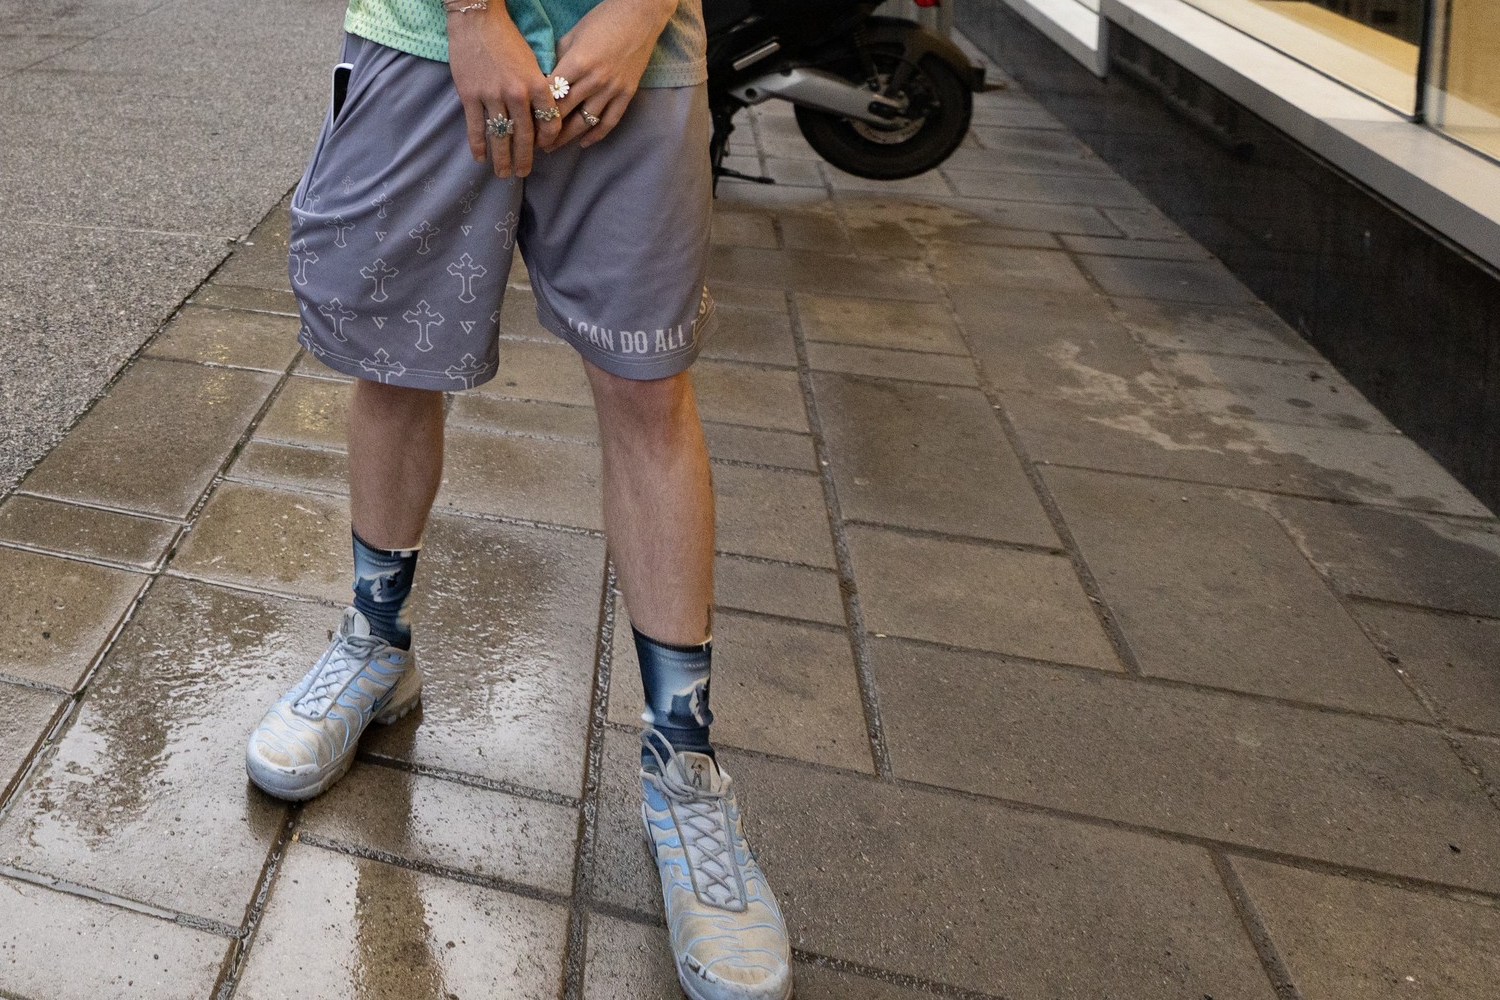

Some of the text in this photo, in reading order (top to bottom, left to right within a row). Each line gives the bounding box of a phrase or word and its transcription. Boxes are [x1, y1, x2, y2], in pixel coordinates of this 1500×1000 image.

[577, 321, 615, 352] CAN
[619, 330, 648, 354] DO
[655, 324, 687, 353] ALL
